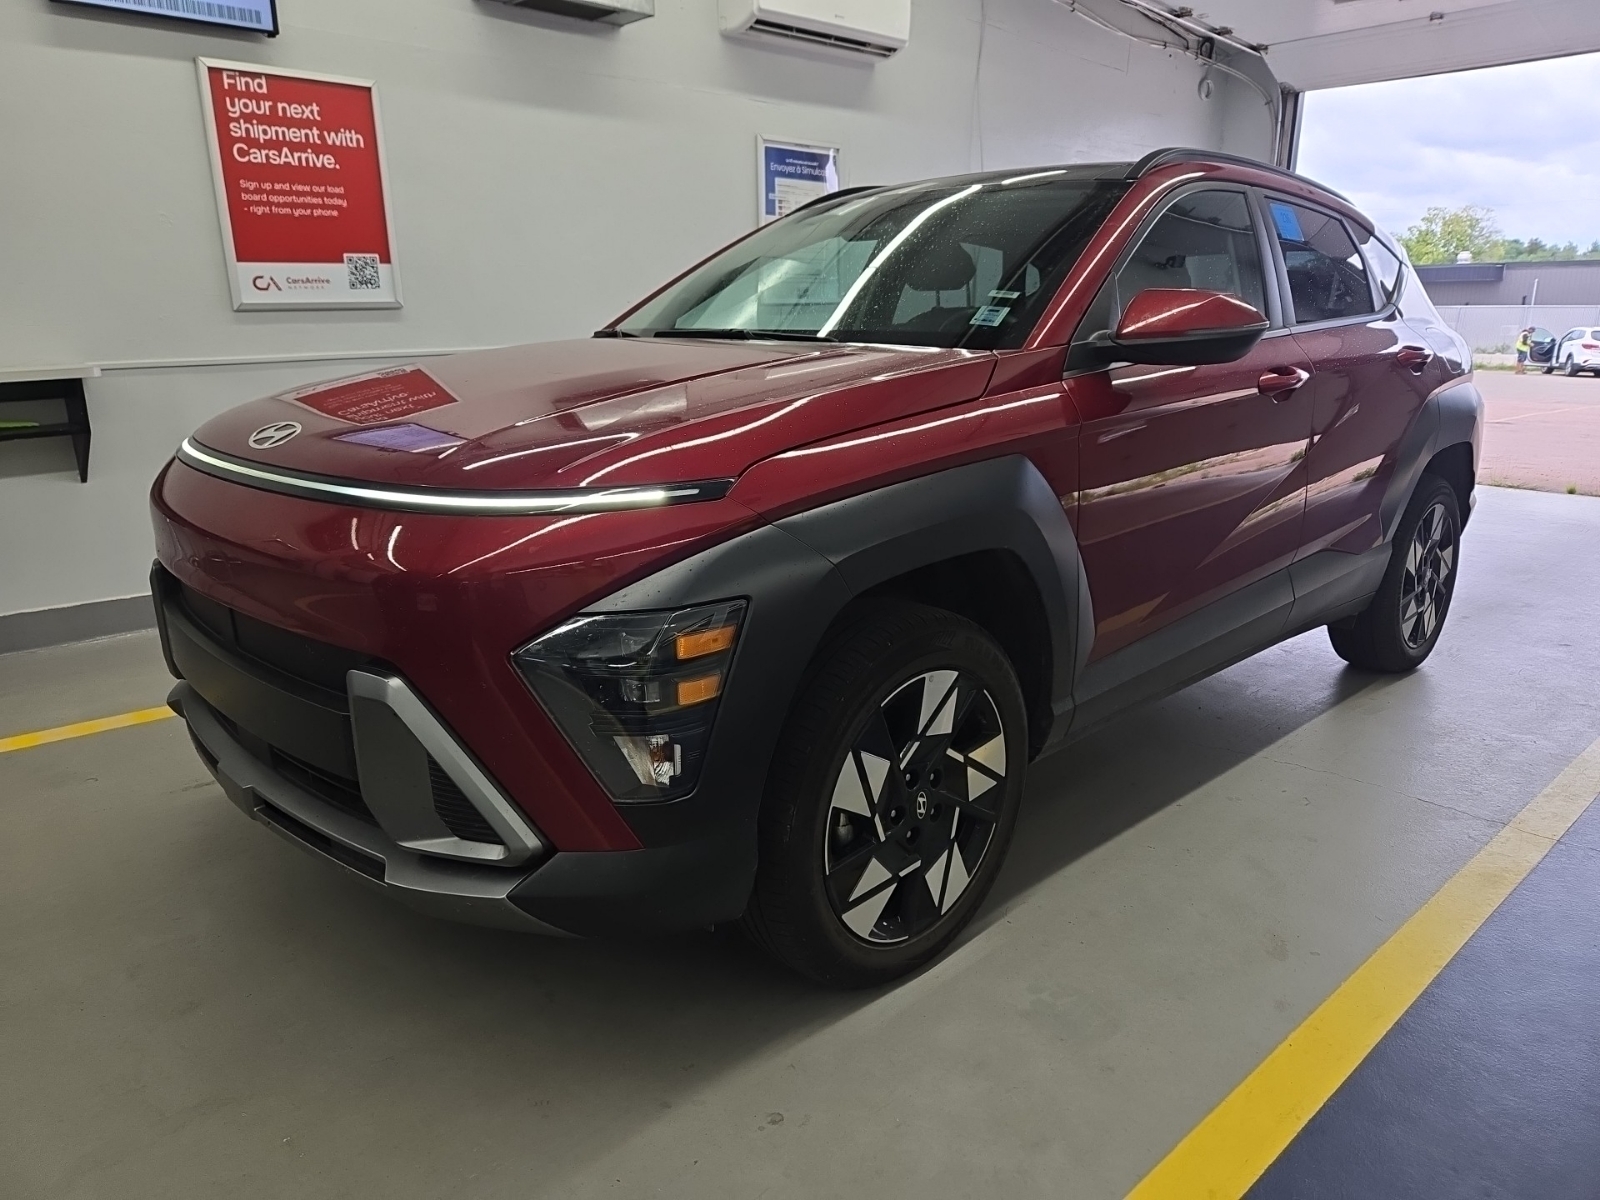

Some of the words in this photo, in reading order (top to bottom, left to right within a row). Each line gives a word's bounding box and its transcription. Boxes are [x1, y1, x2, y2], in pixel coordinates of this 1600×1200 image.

[222, 71, 268, 94] Find
[225, 97, 273, 118] your
[277, 102, 322, 121] next
[229, 119, 322, 145] shipment
[323, 128, 365, 149] with
[232, 143, 341, 170] CarsArrive.
[770, 162, 796, 175] Envoyez
[239, 179, 260, 191] Sign
[261, 181, 273, 191] up
[273, 182, 290, 191] and
[291, 183, 311, 192] view
[312, 185, 326, 193] our
[327, 184, 345, 194] load
[241, 192, 267, 202] board
[268, 194, 323, 205] opportunities
[323, 196, 348, 208] today
[249, 205, 271, 216] right
[272, 205, 292, 215] from
[292, 208, 312, 217] your
[313, 208, 339, 218] phone
[286, 276, 331, 285] CarsArrive
